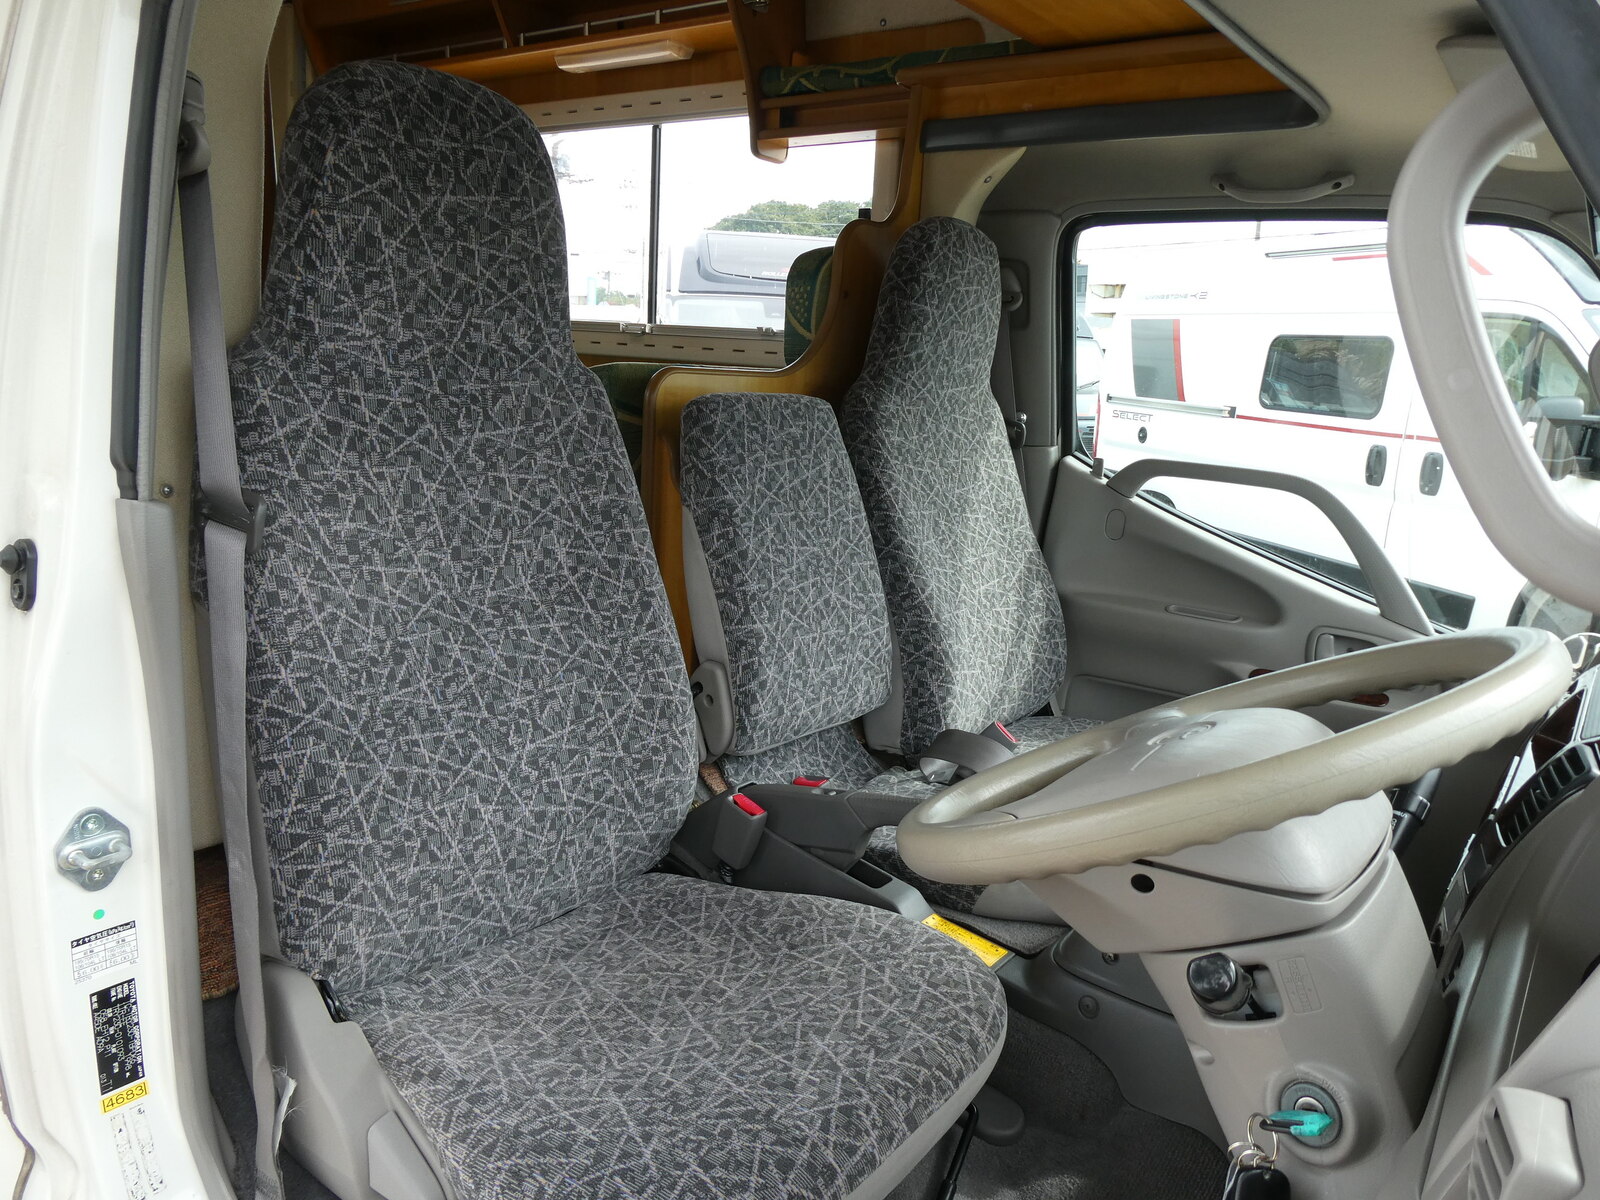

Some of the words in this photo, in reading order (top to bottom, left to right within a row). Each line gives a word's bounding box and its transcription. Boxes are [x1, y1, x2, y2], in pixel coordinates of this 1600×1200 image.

[1112, 410, 1154, 422] SELECT
[133, 1024, 142, 1063] CORPORATION
[106, 1085, 144, 1108] 4683
